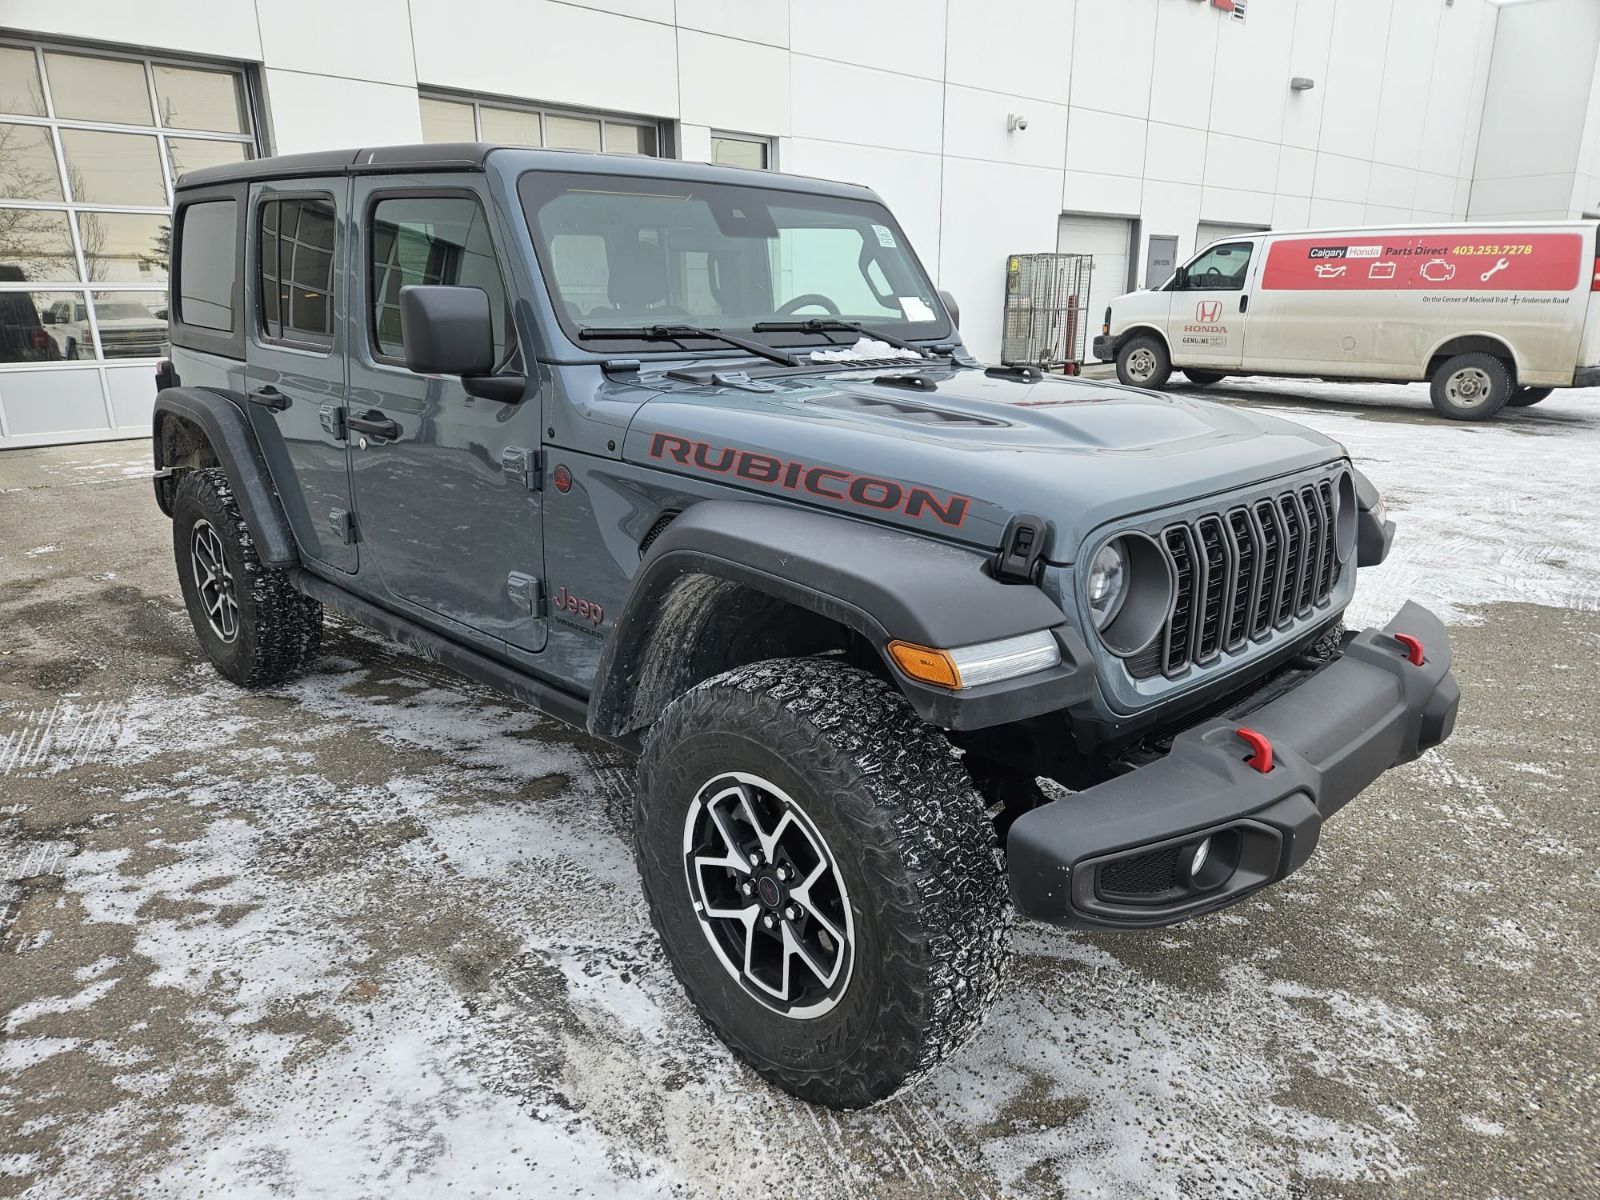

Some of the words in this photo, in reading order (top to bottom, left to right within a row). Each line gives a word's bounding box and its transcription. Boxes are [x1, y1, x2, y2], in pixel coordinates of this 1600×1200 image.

[1310, 247, 1344, 258] Calgary
[1348, 246, 1379, 256] Honda
[1385, 247, 1412, 256] Parts
[1415, 246, 1448, 256] Direct
[1453, 245, 1533, 255] 403.253.7278
[1552, 296, 1570, 304] Road
[1184, 325, 1228, 333] HONDA
[650, 432, 973, 528] RUBICON
[553, 586, 605, 627] Jeep
